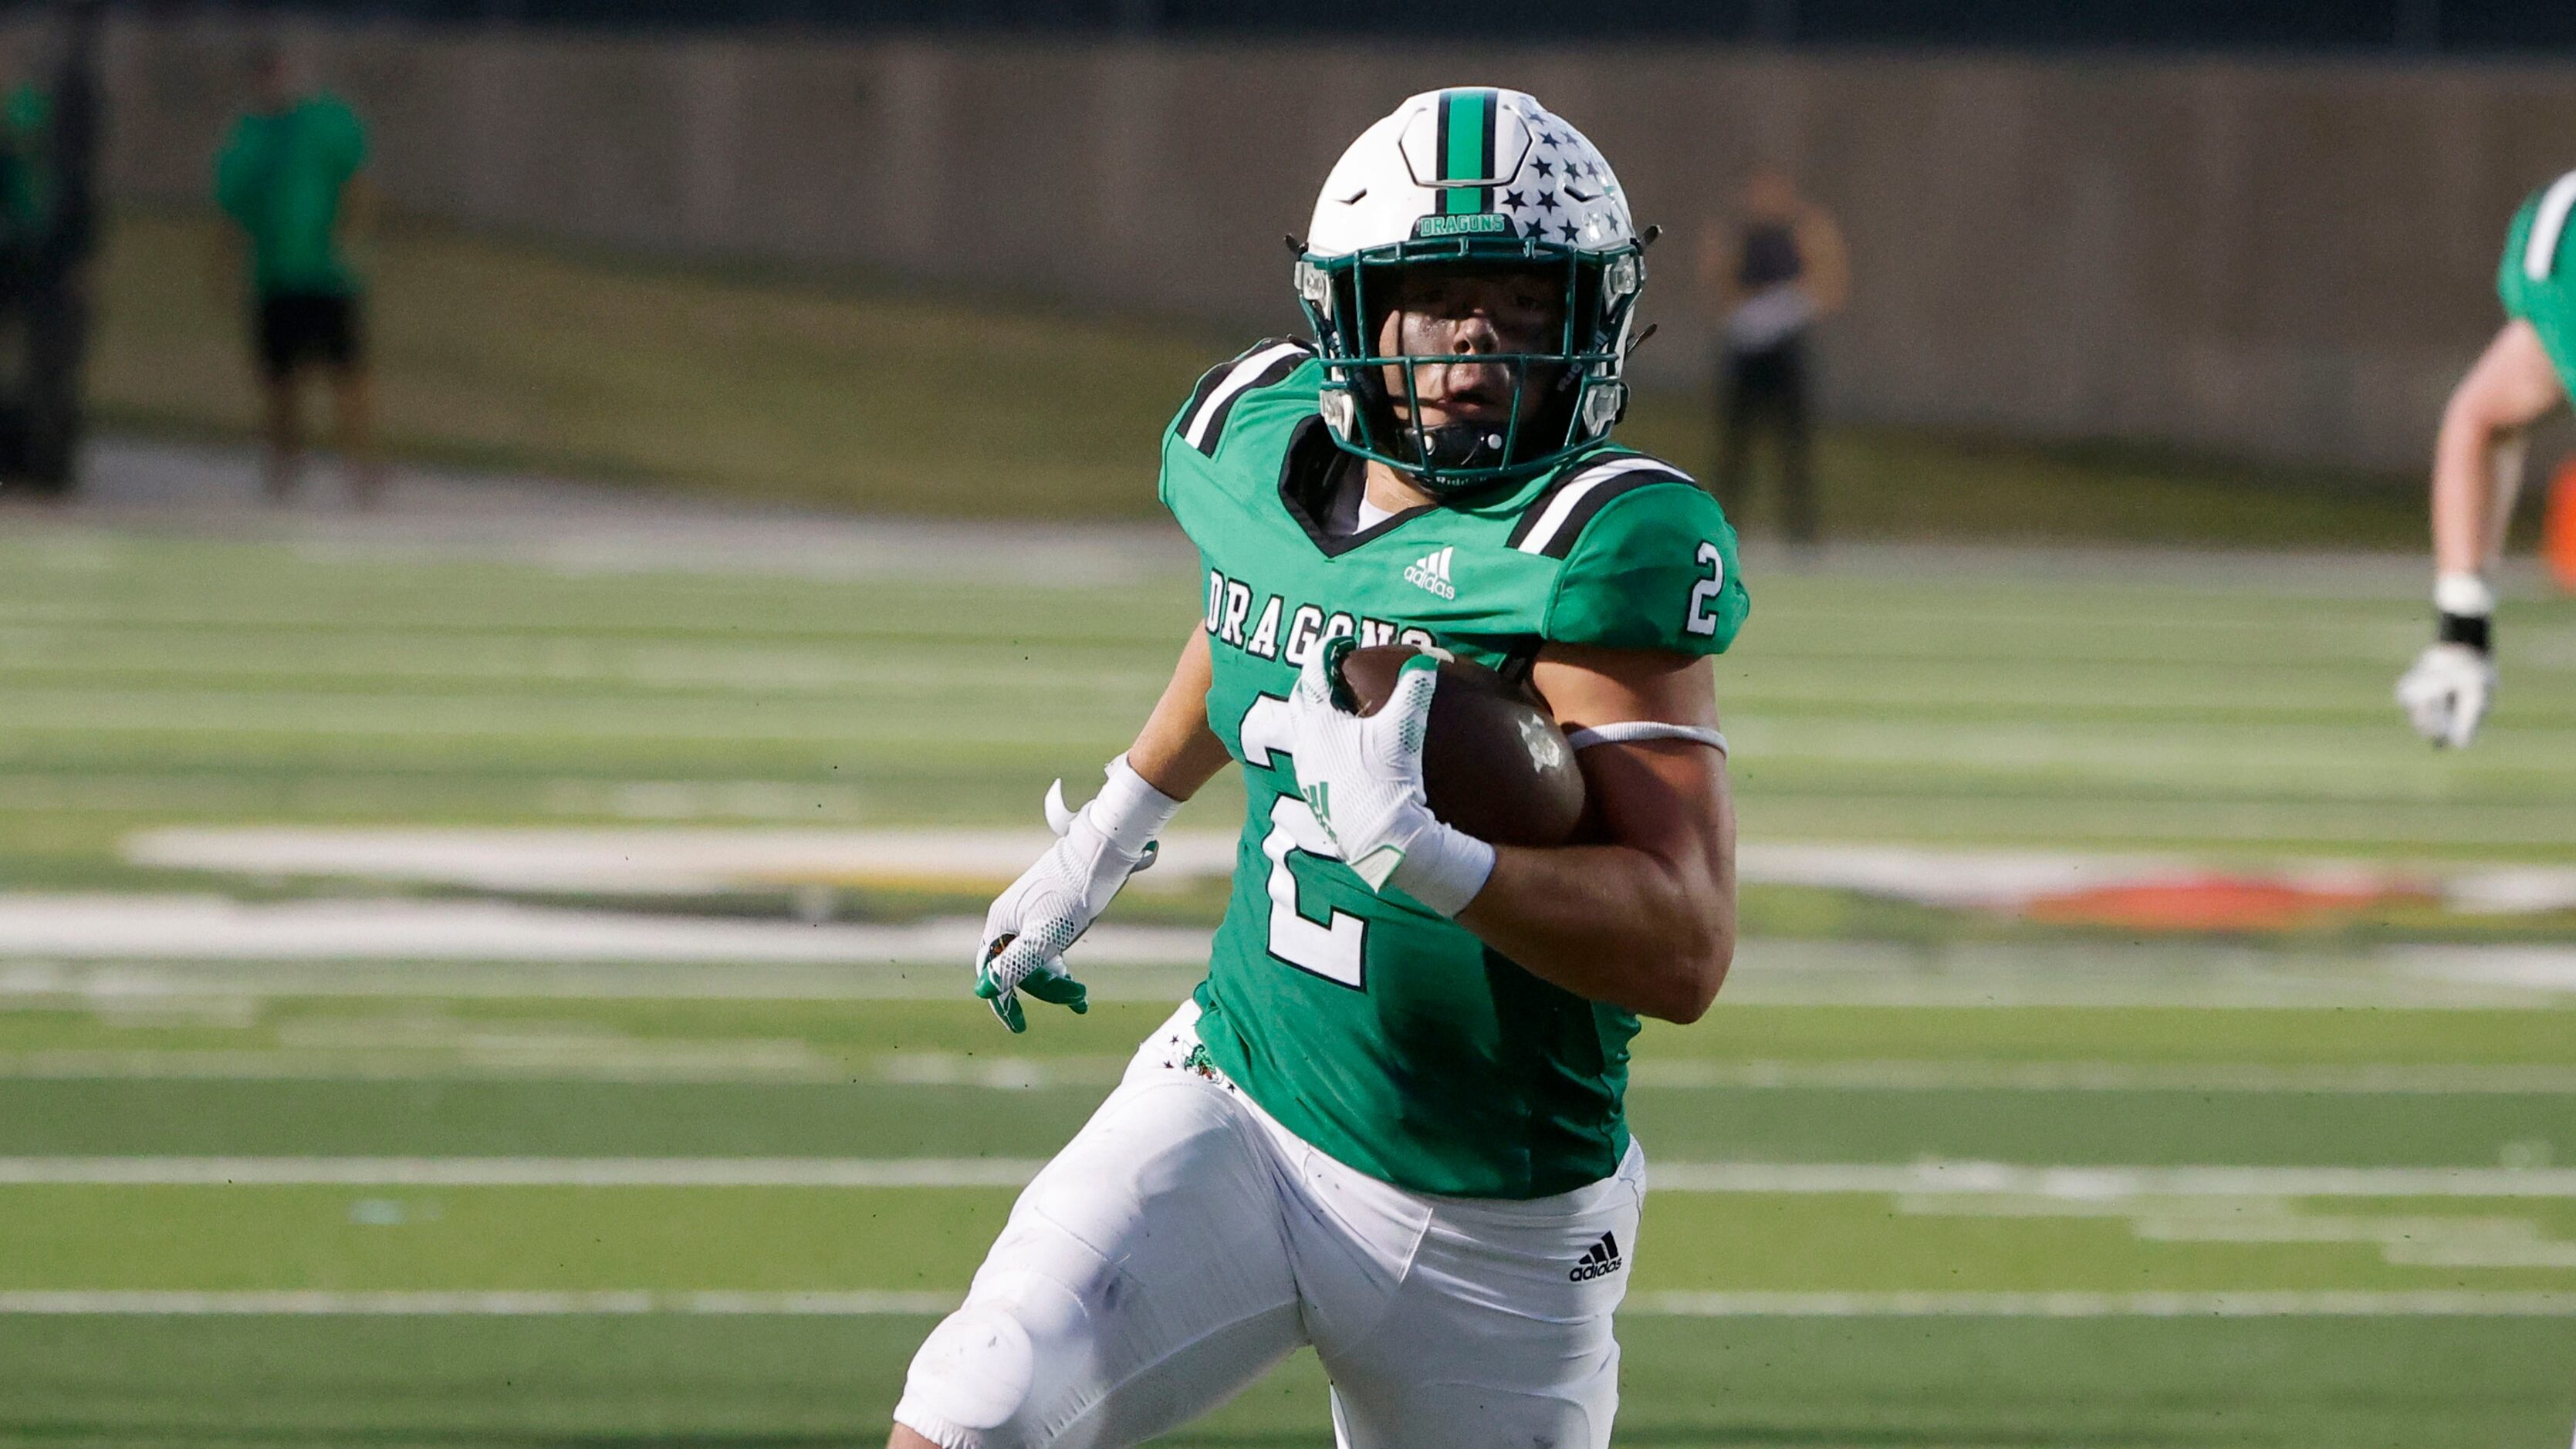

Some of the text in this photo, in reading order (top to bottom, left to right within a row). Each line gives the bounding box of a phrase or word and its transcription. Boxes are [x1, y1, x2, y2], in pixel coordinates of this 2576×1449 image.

[1420, 214, 1504, 237] DRAGONS
[1404, 566, 1455, 600] adidas
[1685, 539, 1725, 636] 2
[1239, 691, 1370, 994] 2
[1569, 1257, 1622, 1282] adidas
